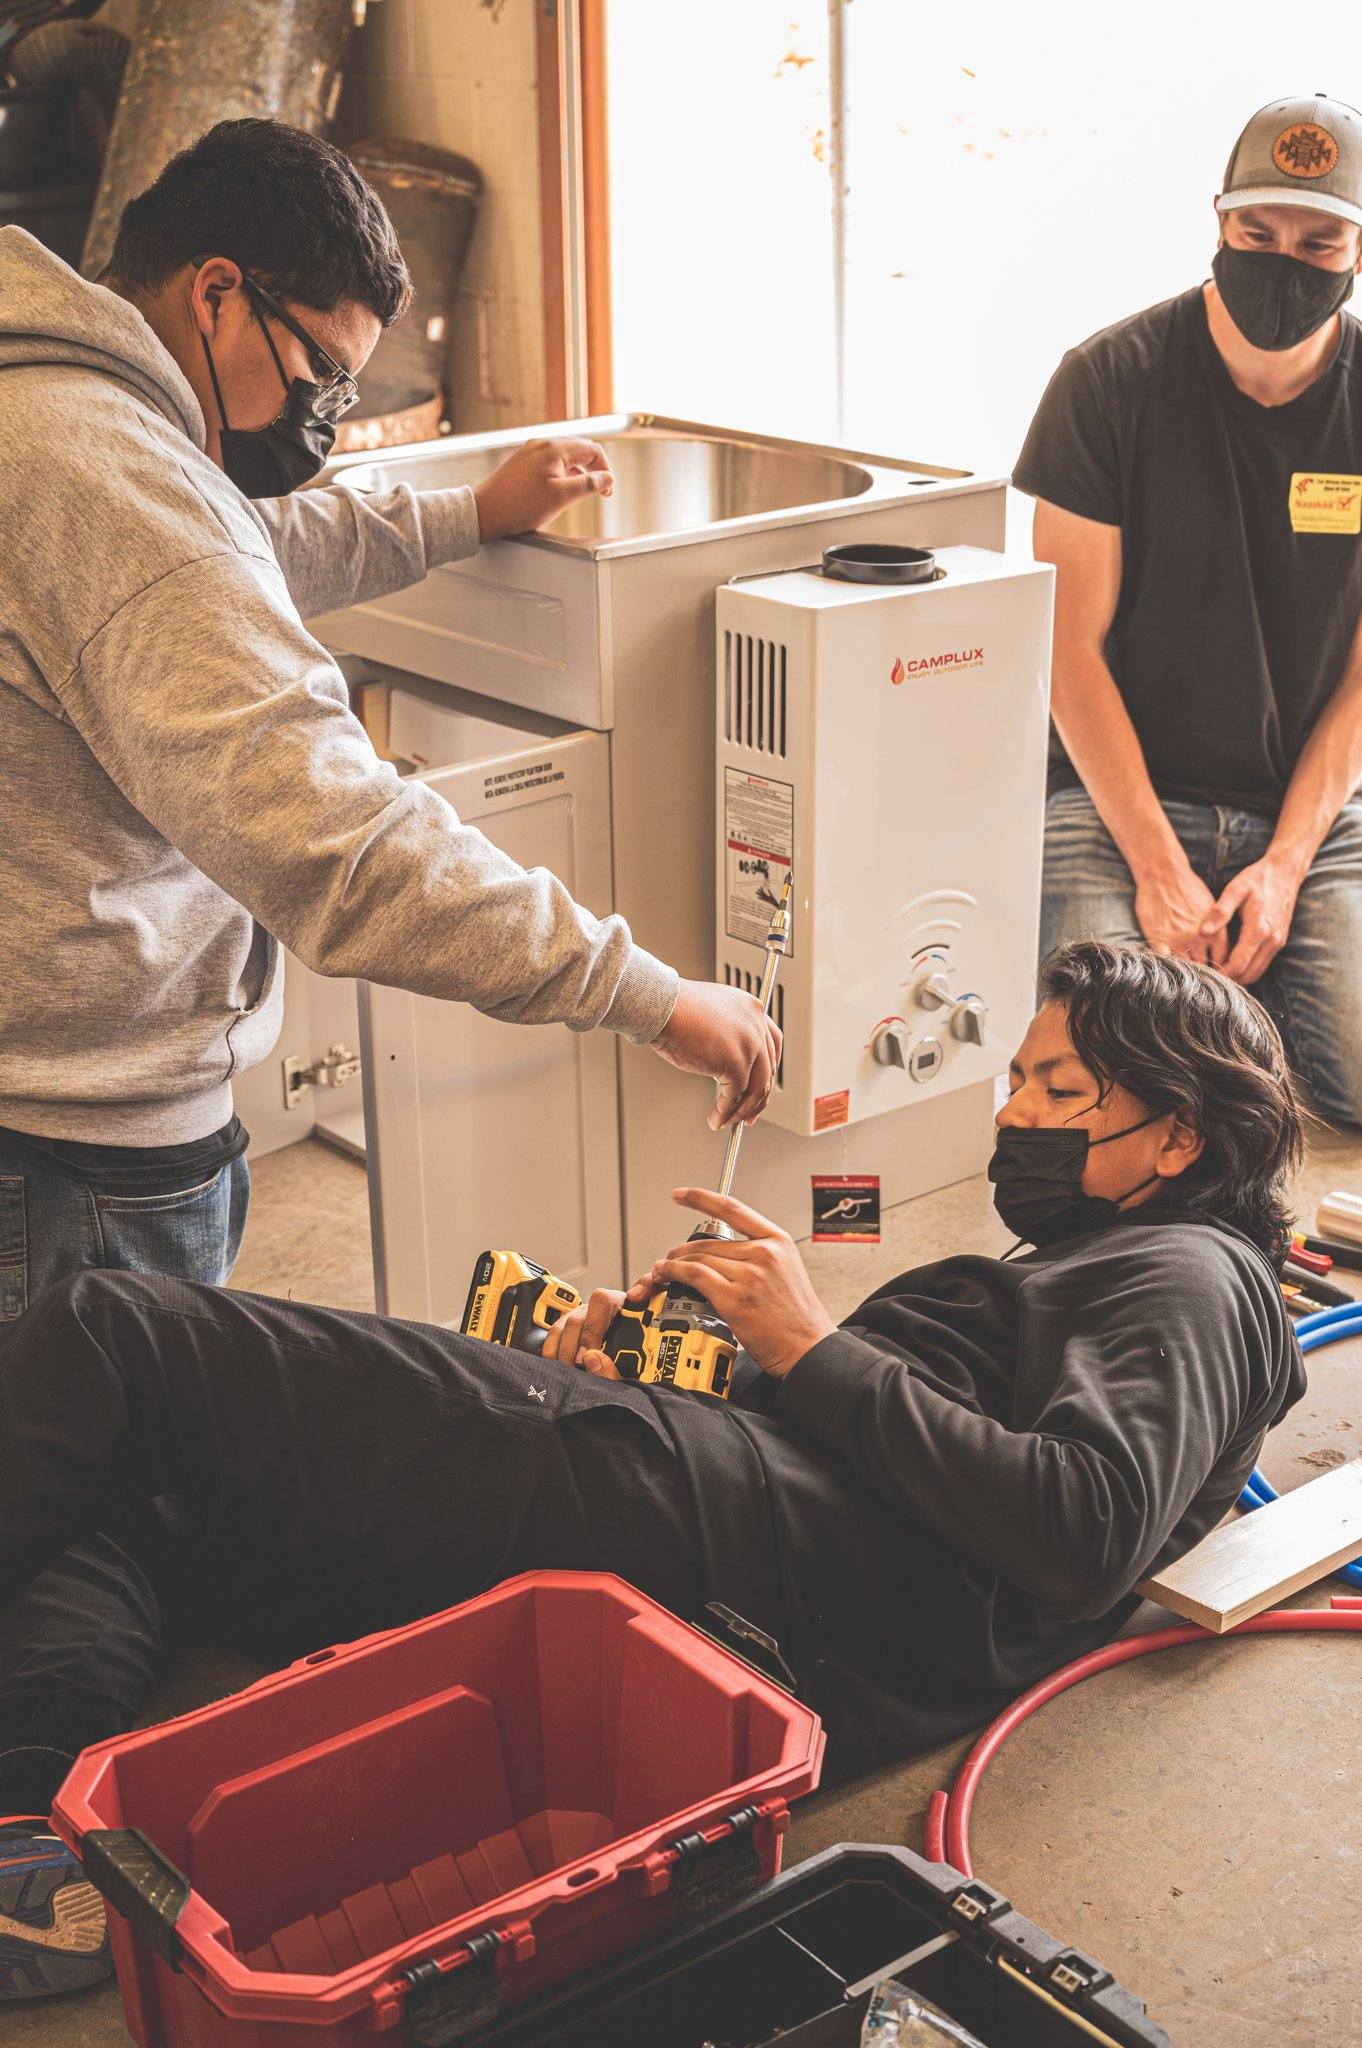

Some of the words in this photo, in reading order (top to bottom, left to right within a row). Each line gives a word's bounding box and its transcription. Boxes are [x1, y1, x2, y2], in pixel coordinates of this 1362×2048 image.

[908, 648, 984, 672] CAMPLUX
[908, 671, 930, 680] ENJOY
[933, 664, 968, 675] OUTDOOR
[470, 1294, 485, 1333] DEWALT
[682, 1302, 692, 1311] 15
[661, 1336, 682, 1382] DEWA
